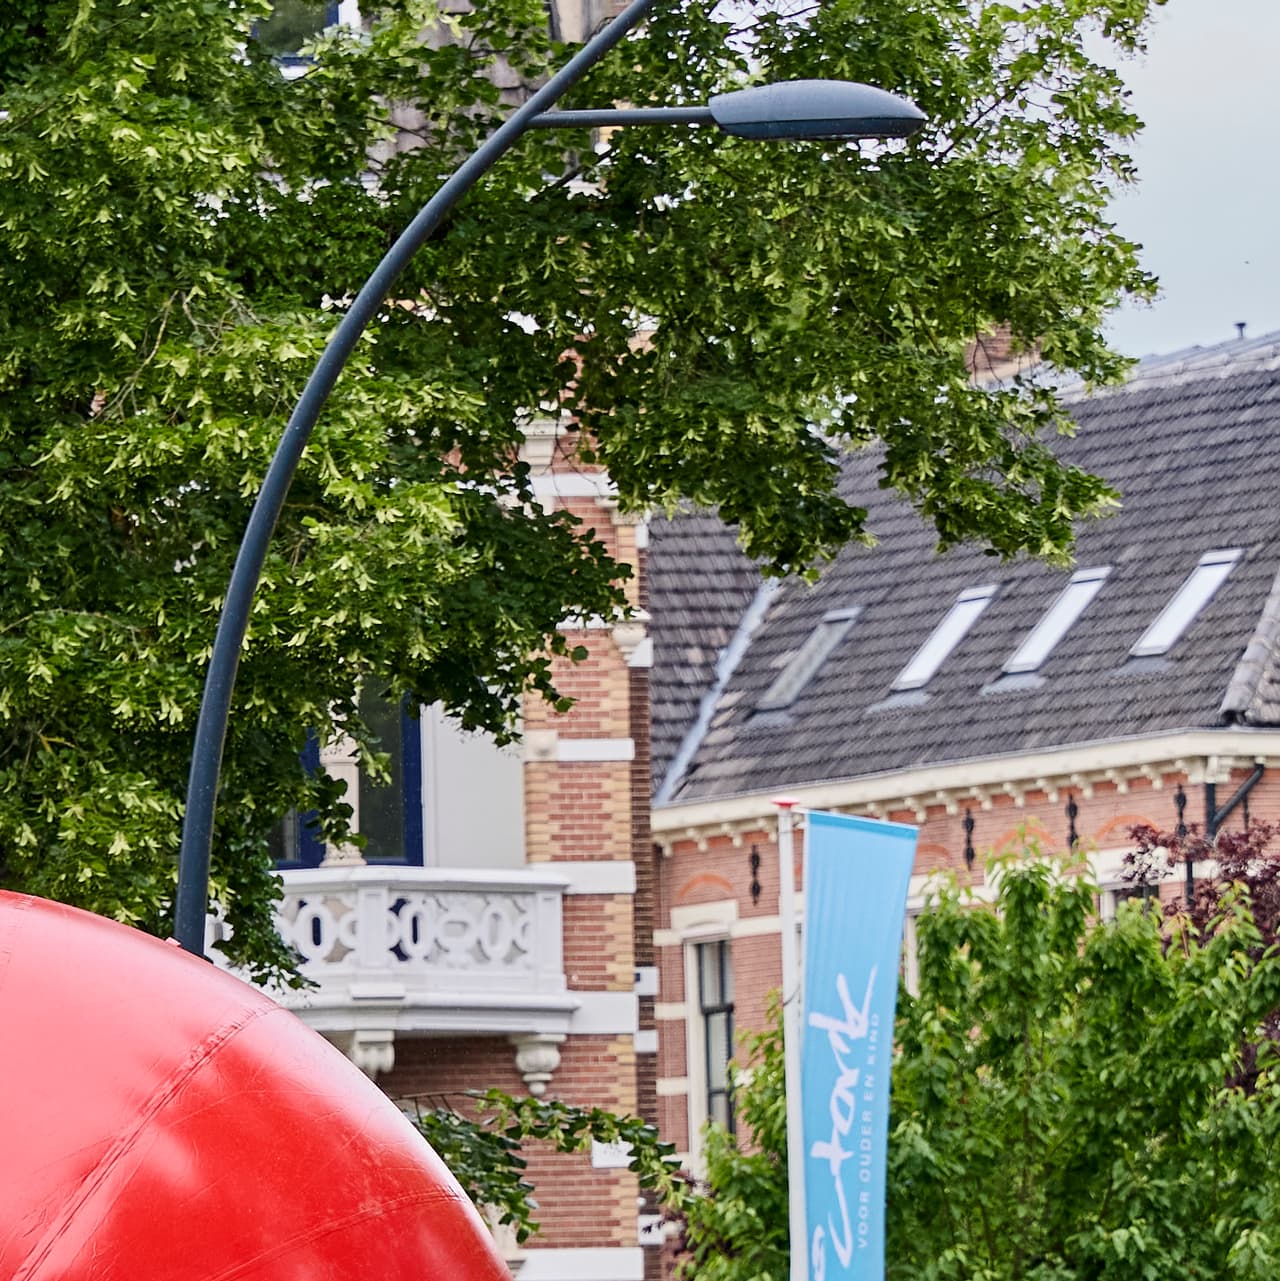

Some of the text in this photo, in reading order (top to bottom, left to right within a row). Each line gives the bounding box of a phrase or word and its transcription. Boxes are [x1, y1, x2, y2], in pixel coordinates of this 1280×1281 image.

[856, 1013, 881, 1250] VOOR OUDER EN KIND
